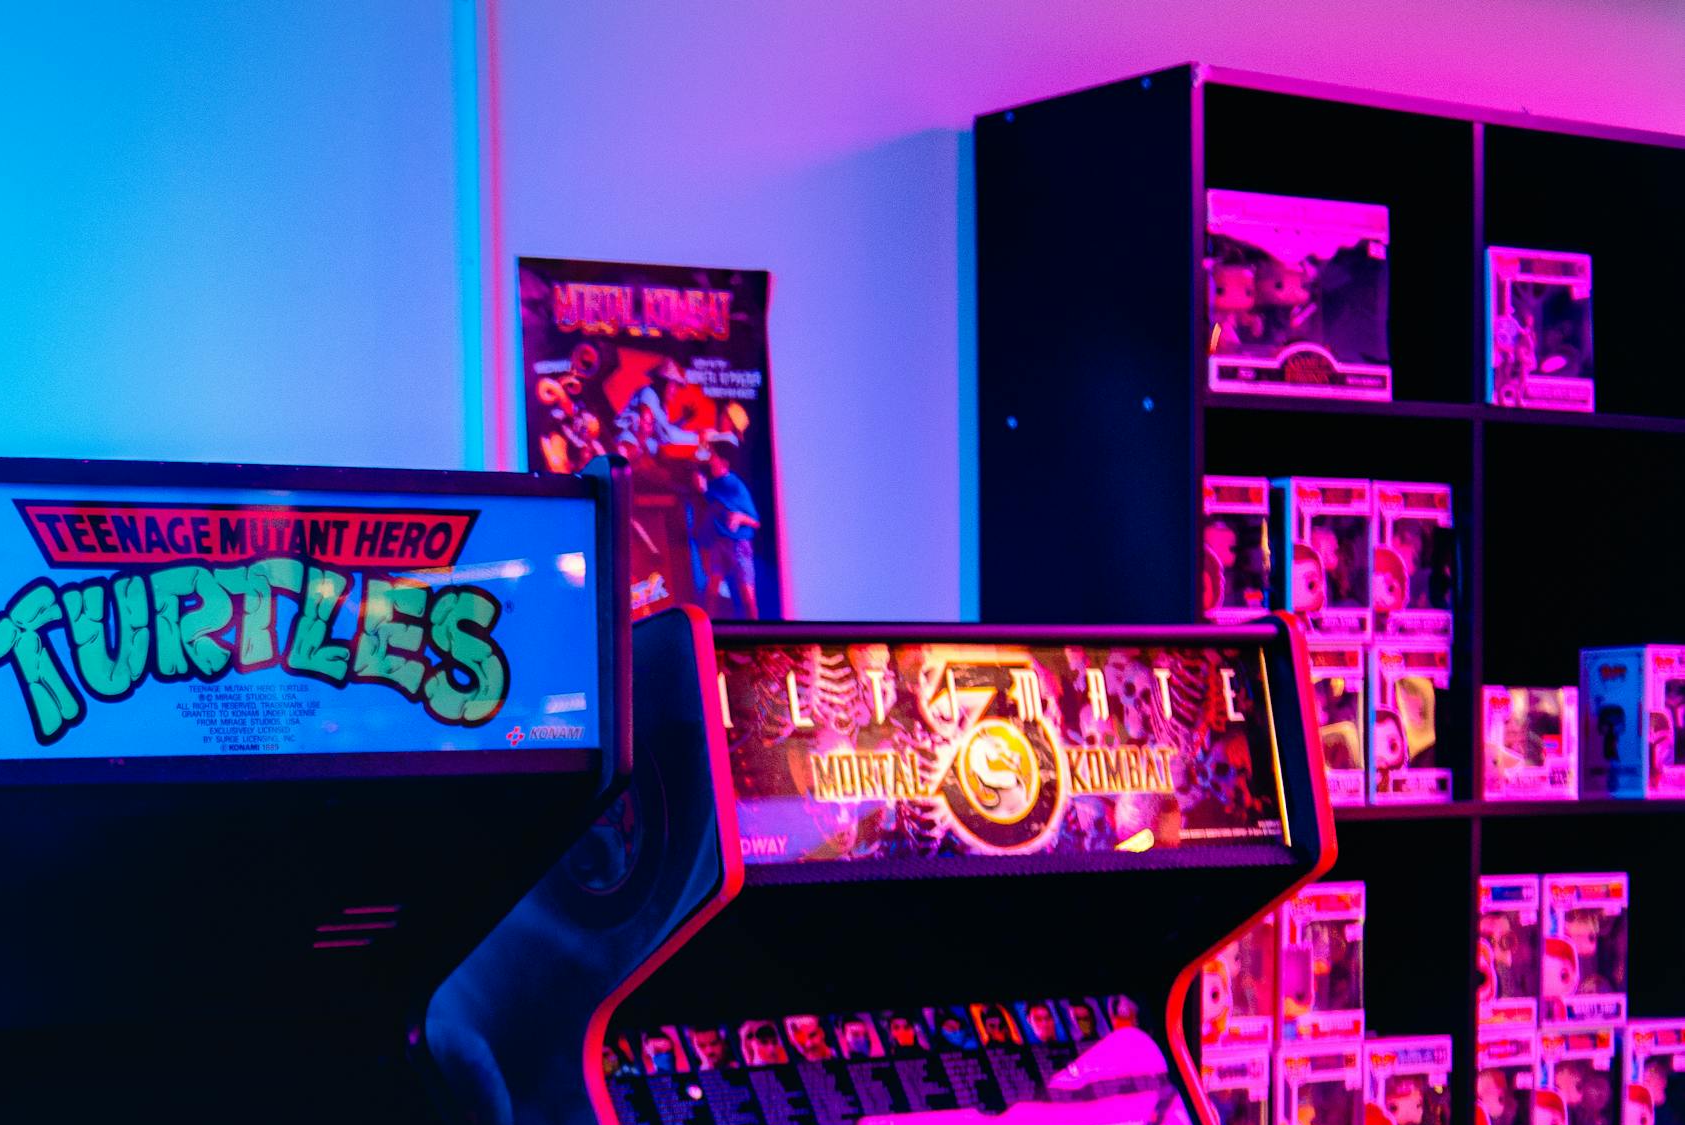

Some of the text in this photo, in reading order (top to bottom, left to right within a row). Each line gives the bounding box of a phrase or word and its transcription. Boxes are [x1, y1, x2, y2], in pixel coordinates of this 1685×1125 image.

[38, 513, 453, 562] TEENAGE MUTANT HERO
[529, 725, 585, 741] KONAMI
[810, 750, 929, 801] MORTAL
[1066, 747, 1177, 794] KOMBAT
[740, 836, 787, 856] DWAY
